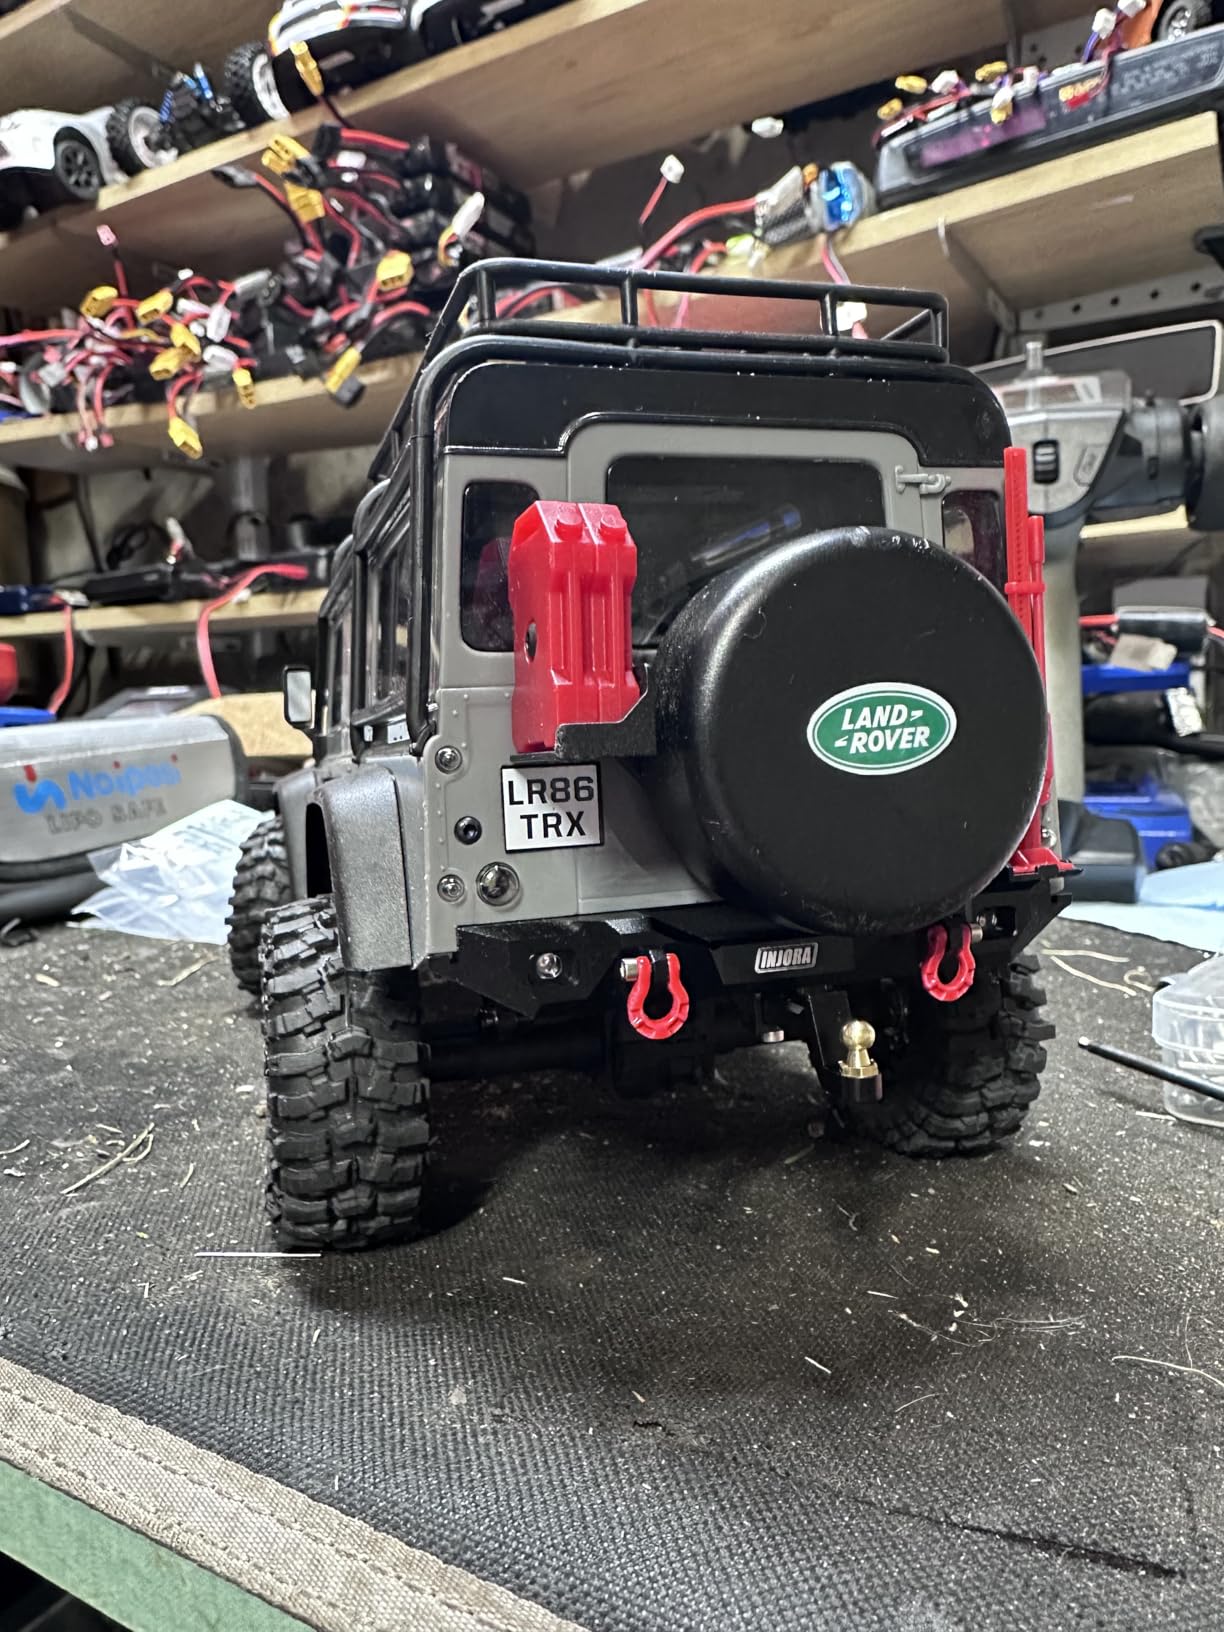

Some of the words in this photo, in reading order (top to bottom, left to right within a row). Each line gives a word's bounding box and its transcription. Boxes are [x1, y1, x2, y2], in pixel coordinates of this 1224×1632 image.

[841, 703, 908, 731] LAND
[849, 725, 931, 754] ROVER
[508, 776, 594, 805] LR86
[519, 810, 586, 840] TRX
[760, 946, 811, 969] INJORA
